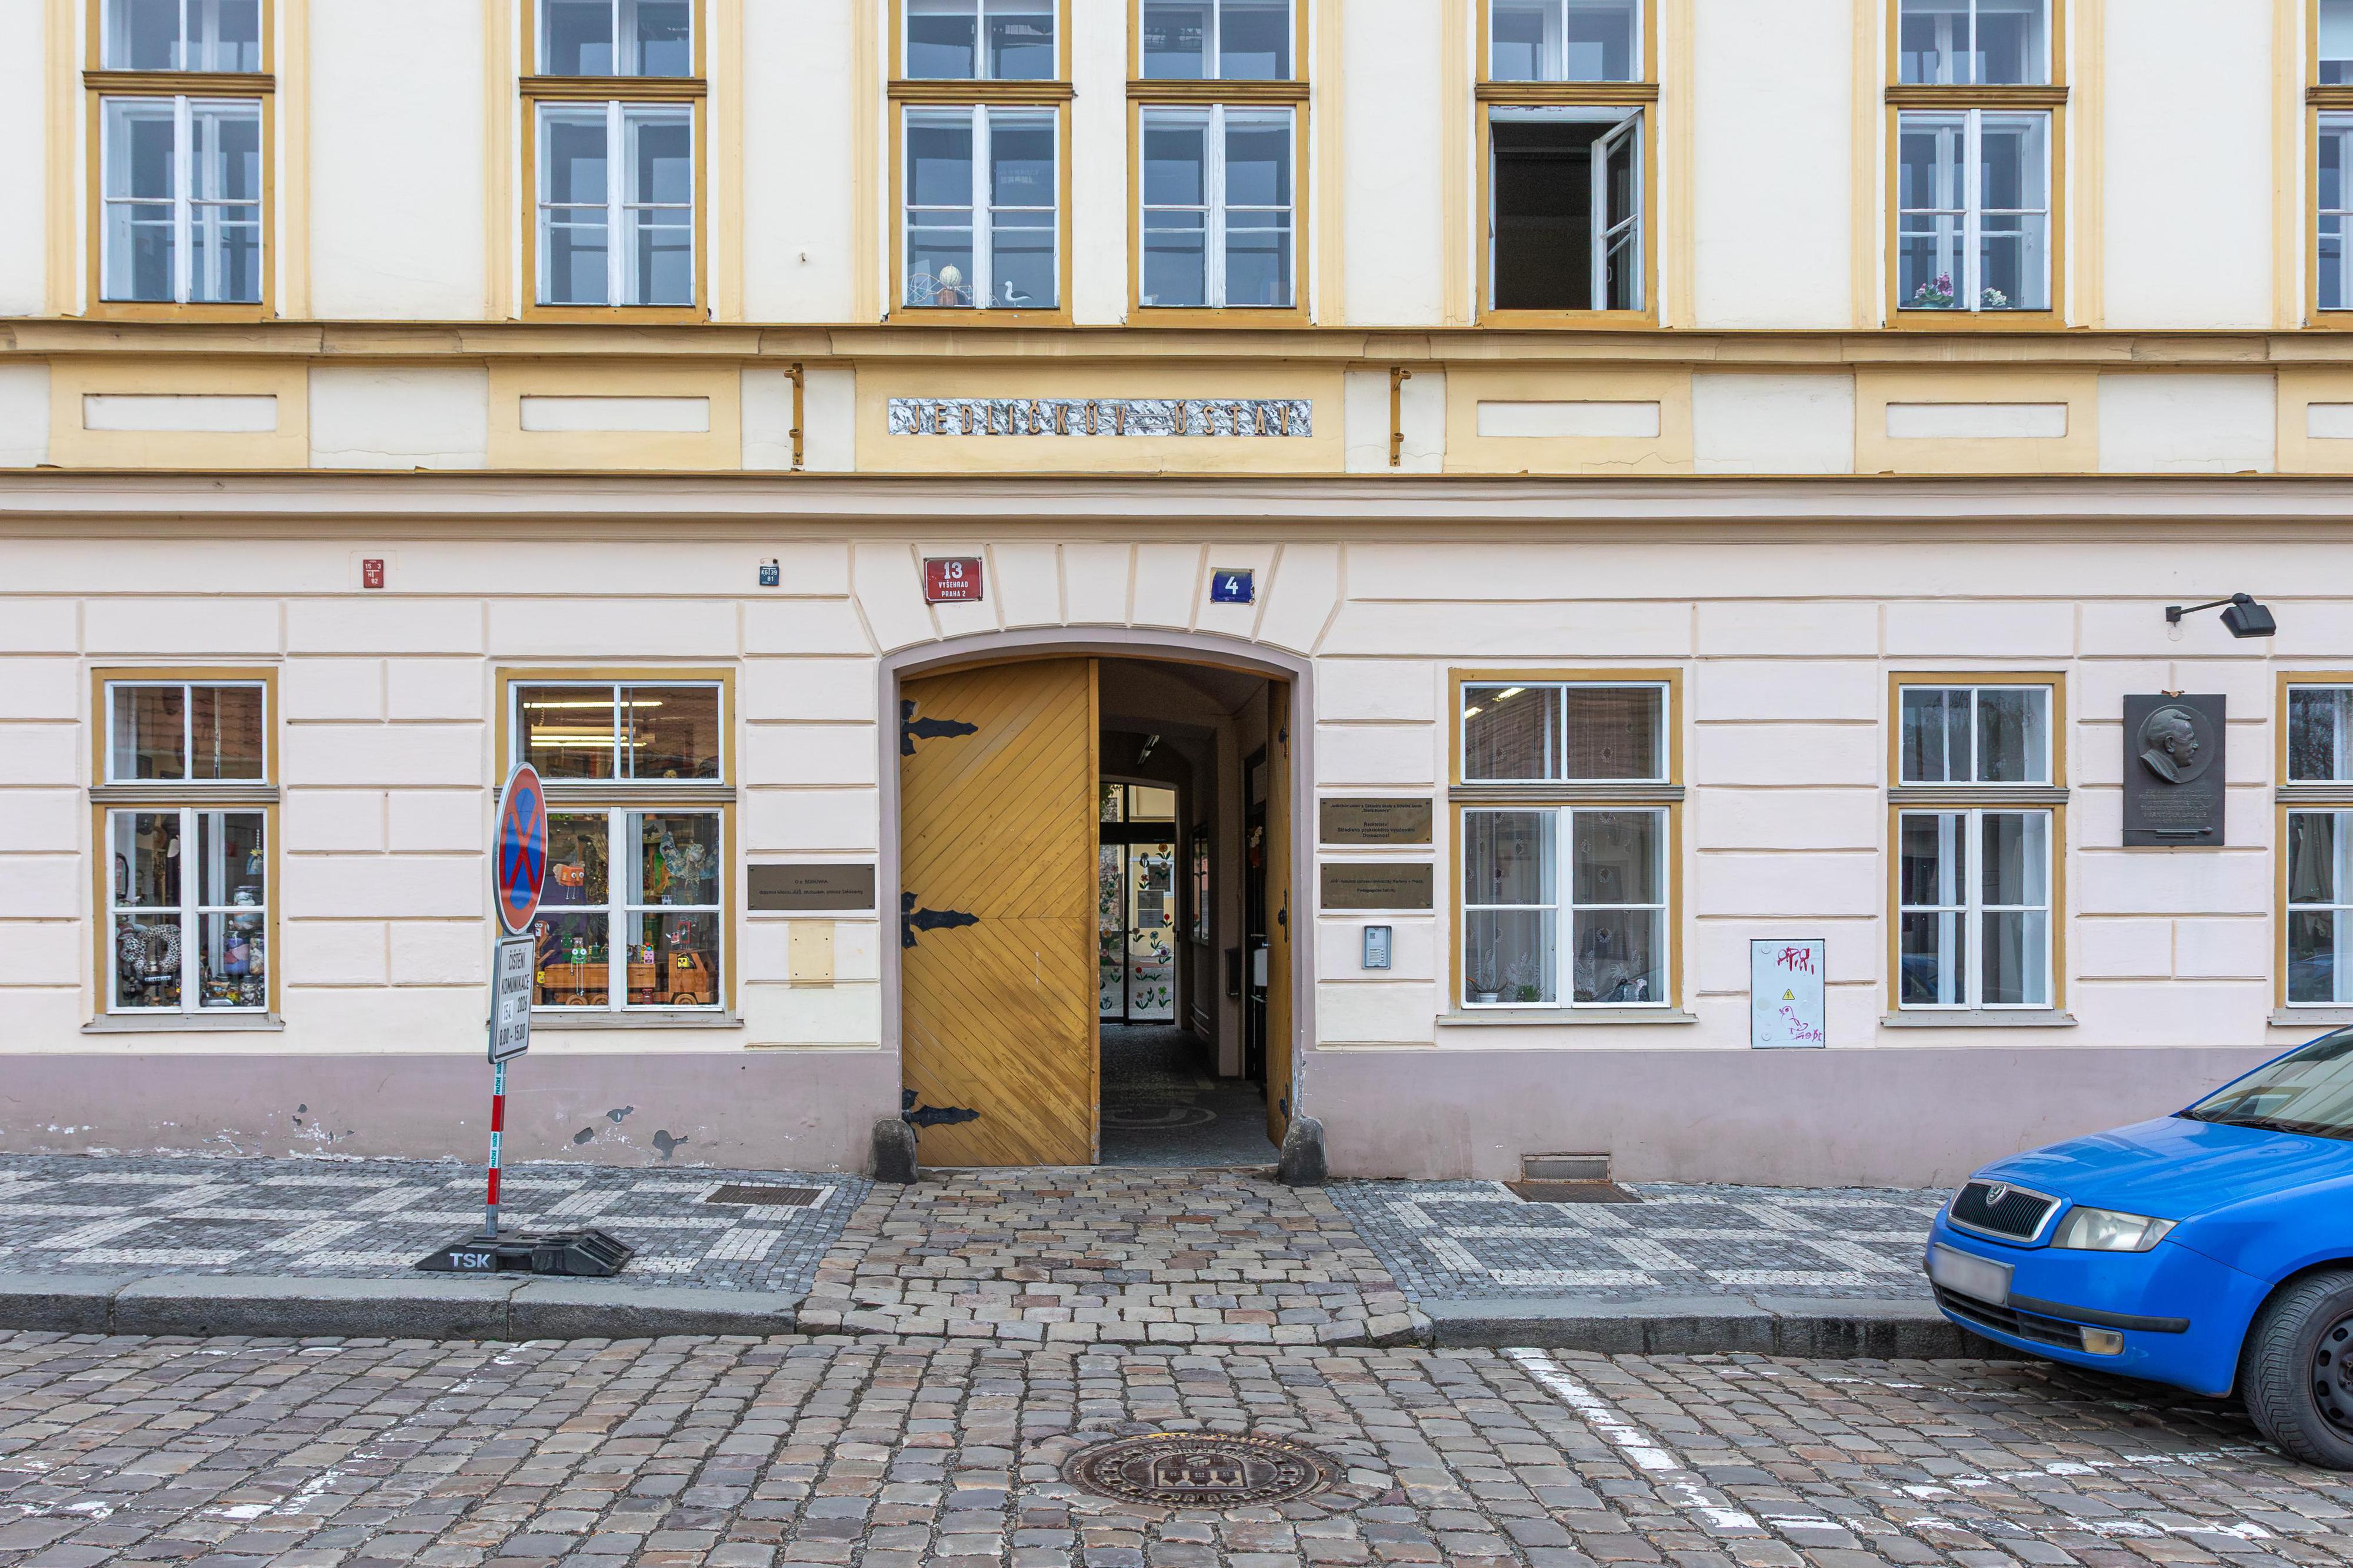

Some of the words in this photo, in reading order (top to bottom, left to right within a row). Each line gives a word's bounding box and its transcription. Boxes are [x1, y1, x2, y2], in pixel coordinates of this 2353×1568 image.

[909, 401, 1126, 434] JEDLIČKŮV
[1174, 401, 1290, 434] ÚSTAV
[944, 562, 962, 579] 13
[938, 580, 968, 588] VYŠEHRAD
[1225, 576, 1238, 595] 4
[508, 948, 526, 970] ČIŠTĚNÍ
[501, 973, 529, 995] KOMUNIKACE
[449, 1253, 491, 1268] TSK
